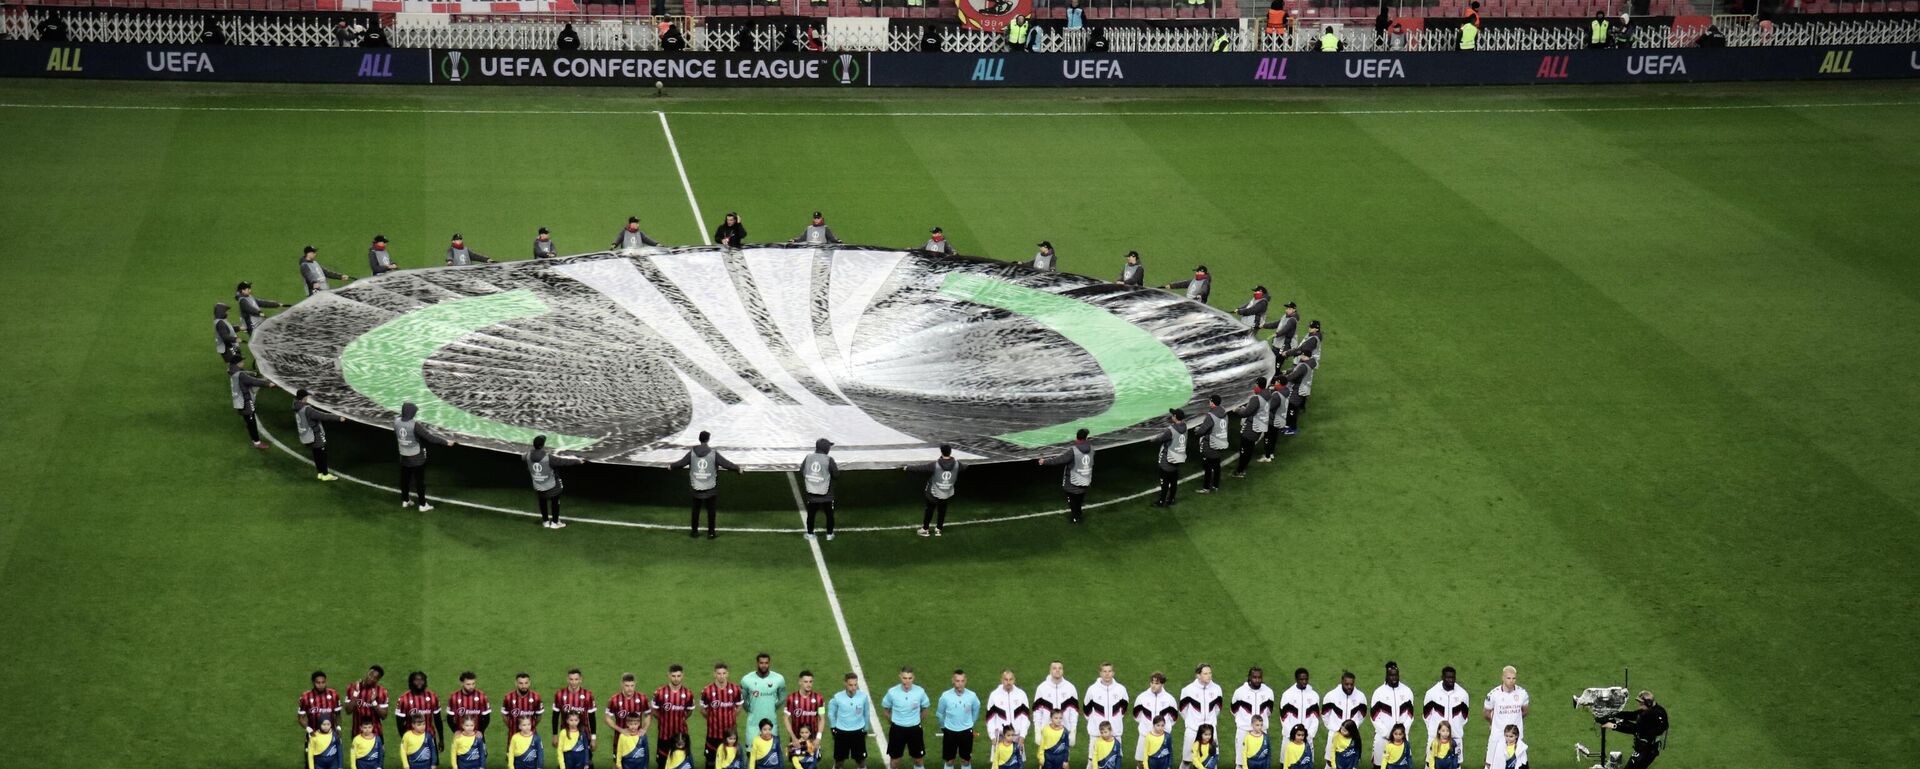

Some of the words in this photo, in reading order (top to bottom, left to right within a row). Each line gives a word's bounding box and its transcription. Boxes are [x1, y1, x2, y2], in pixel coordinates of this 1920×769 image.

[46, 47, 83, 72] ALL
[146, 51, 215, 73] UEFA
[358, 53, 393, 77] ALL
[480, 57, 548, 77] UEFA
[552, 58, 717, 79] CONFERENCE
[971, 57, 1005, 81] ALL
[1062, 59, 1124, 80] UEFA
[1253, 57, 1288, 81] ALL
[1344, 58, 1406, 79] UEFA
[1536, 55, 1569, 78] ALL
[1626, 55, 1687, 75] UEFA
[1818, 50, 1853, 73] ALL
